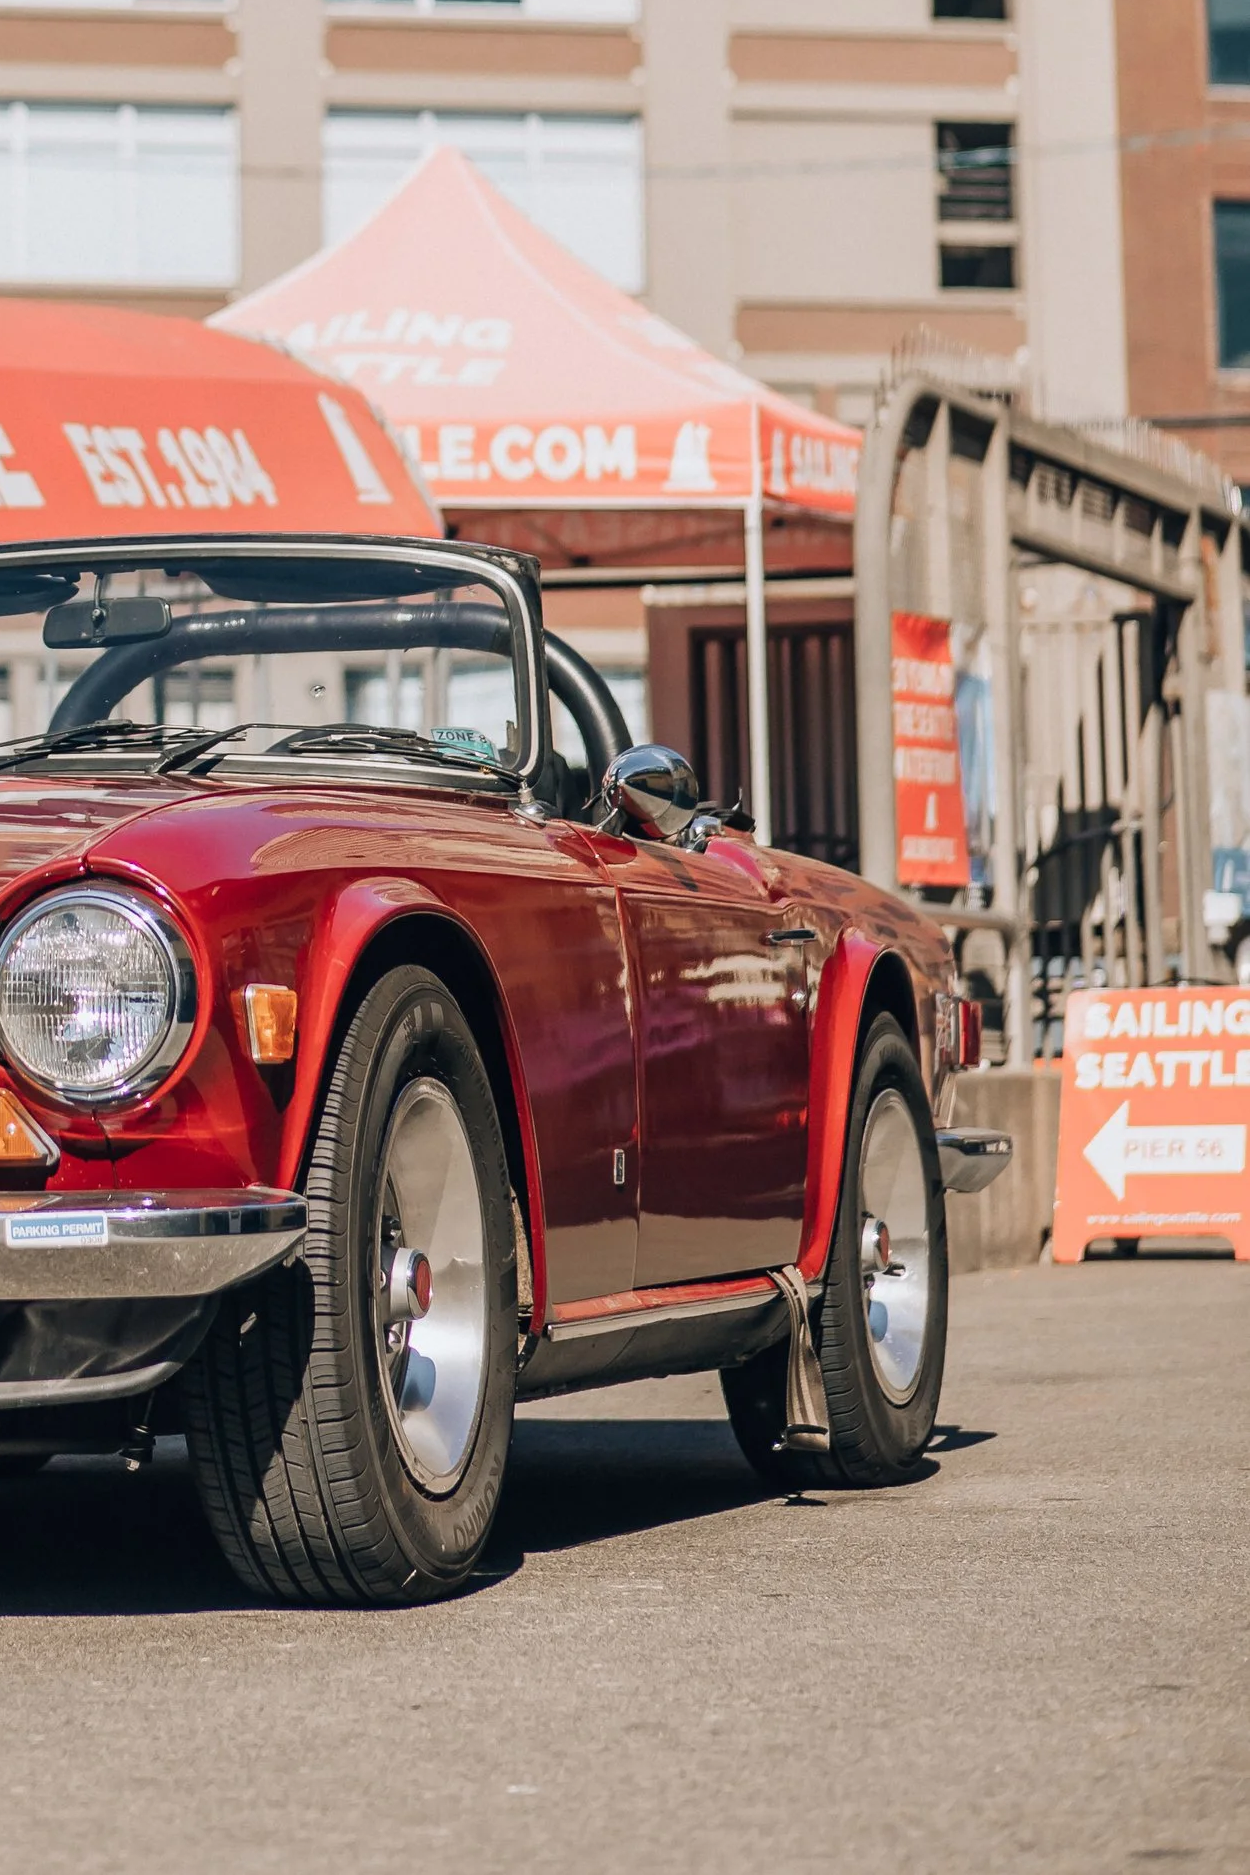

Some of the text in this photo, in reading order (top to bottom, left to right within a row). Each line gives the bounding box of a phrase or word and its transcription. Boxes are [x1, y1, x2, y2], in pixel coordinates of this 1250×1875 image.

[404, 424, 637, 482] LE.COM
[436, 731, 476, 743] ZONE
[1083, 998, 1250, 1039] SAILING
[1124, 1138, 1185, 1159] PIER
[12, 1221, 103, 1238] PARKING PERMIT
[453, 1452, 503, 1549] KUMHO
